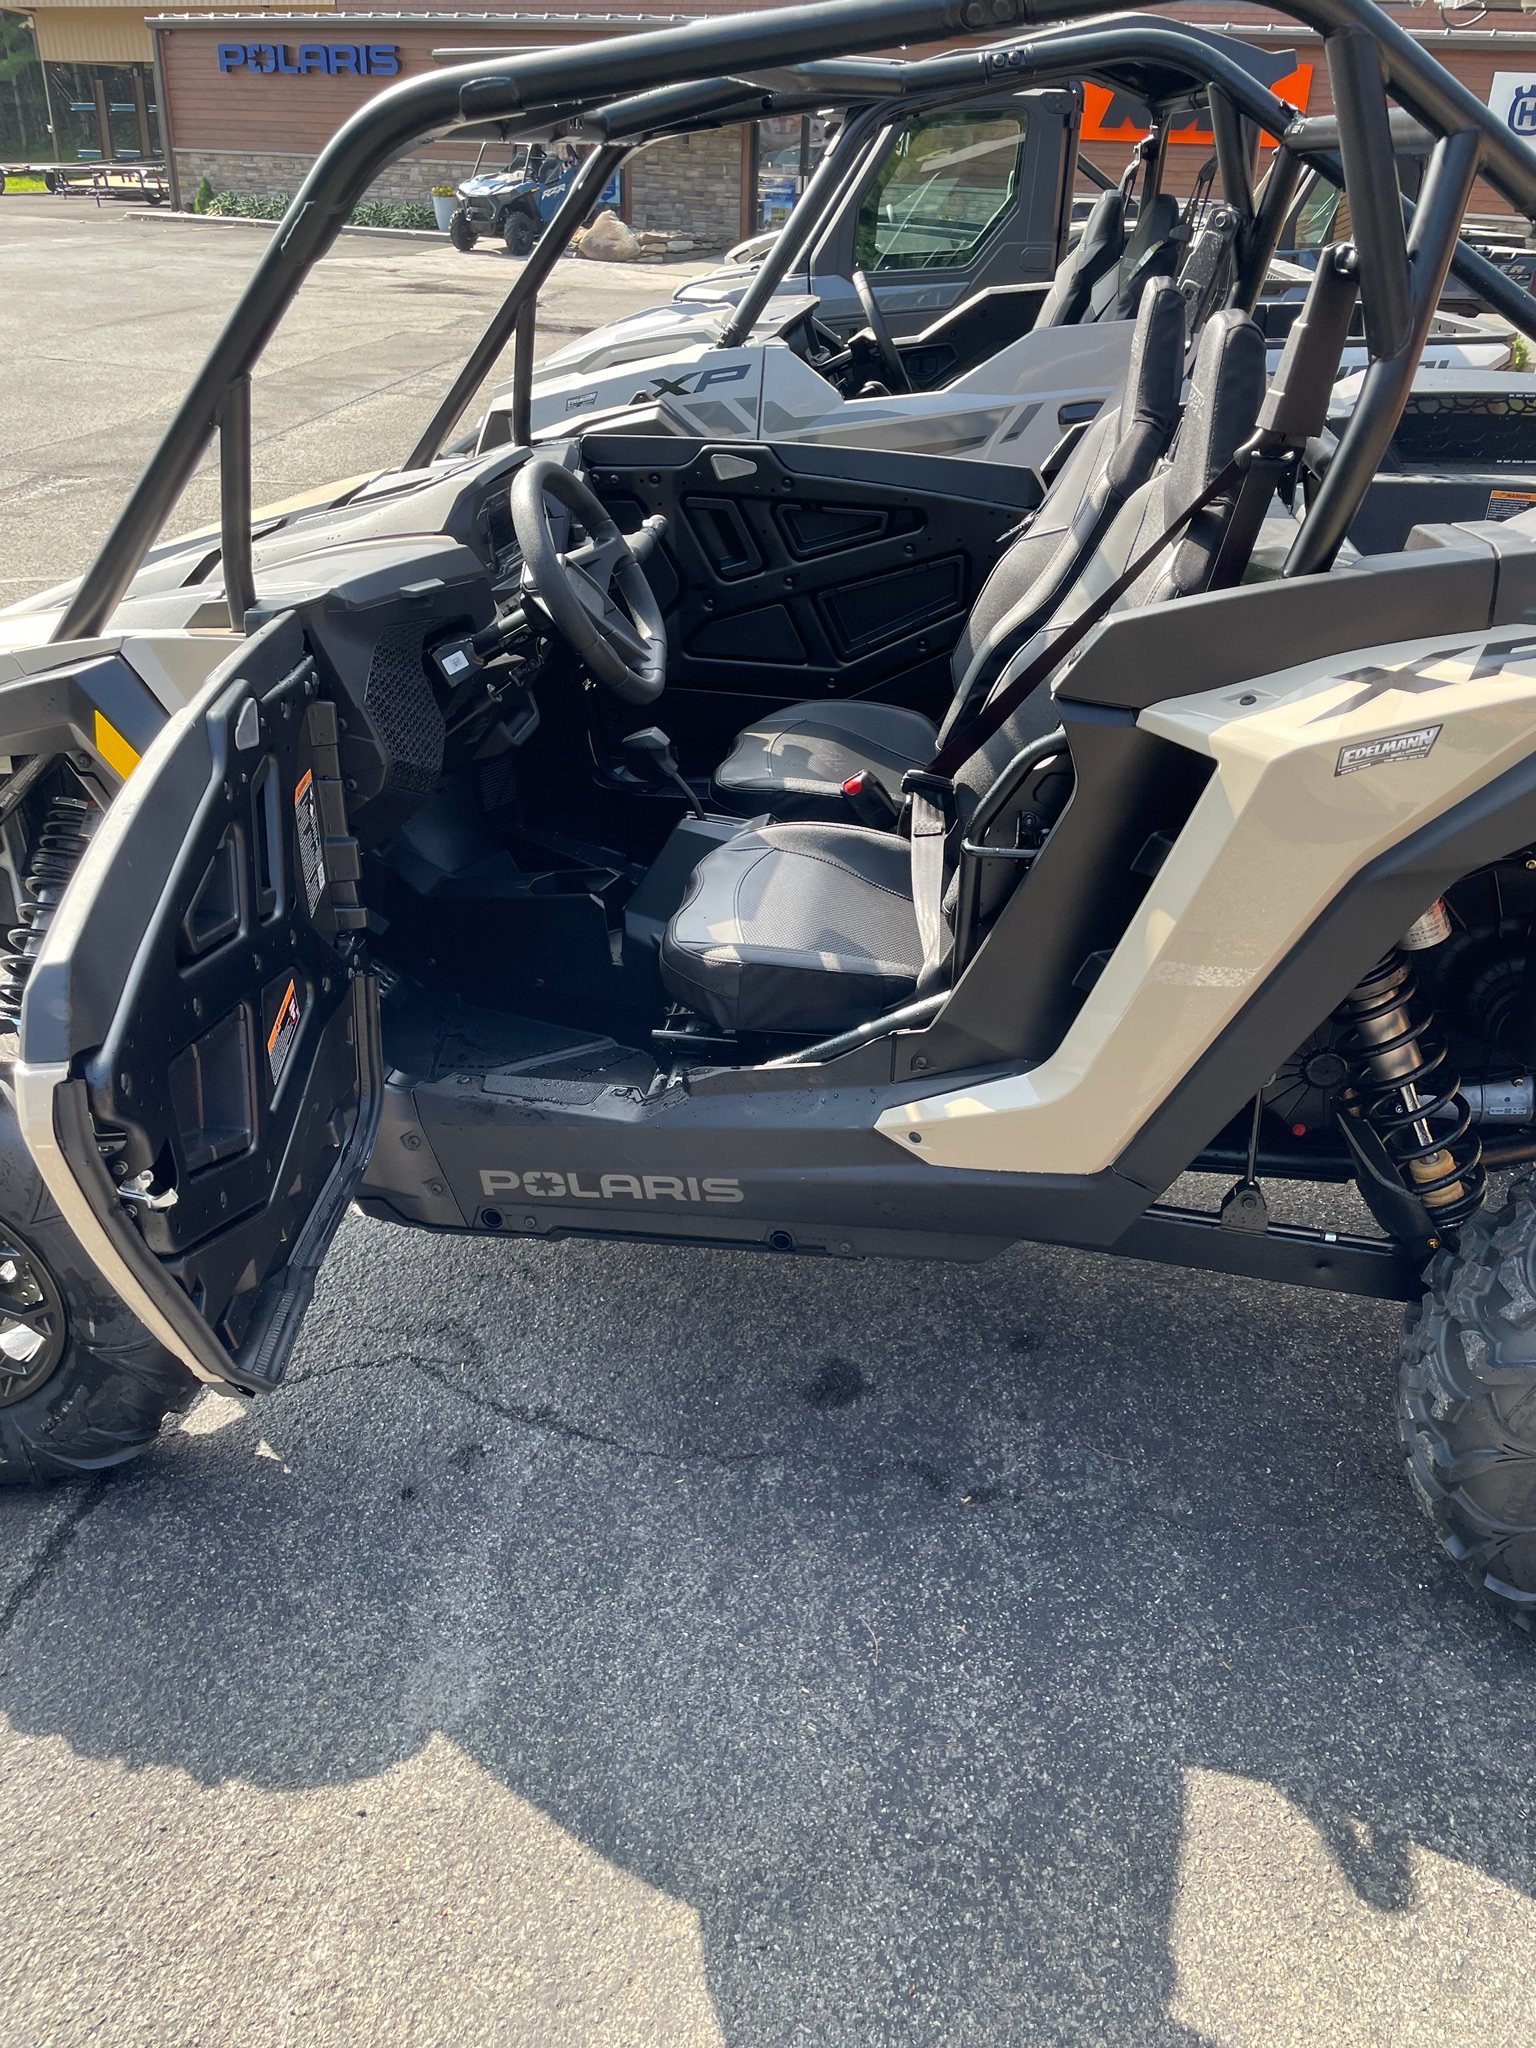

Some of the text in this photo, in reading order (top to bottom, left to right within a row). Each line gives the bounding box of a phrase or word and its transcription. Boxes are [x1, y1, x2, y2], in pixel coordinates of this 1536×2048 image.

[218, 44, 400, 75] POLARIS
[541, 183, 567, 200] RZR
[649, 363, 752, 398] XP
[1341, 728, 1436, 767] EDELMANN
[479, 1170, 744, 1203] POLARIS
